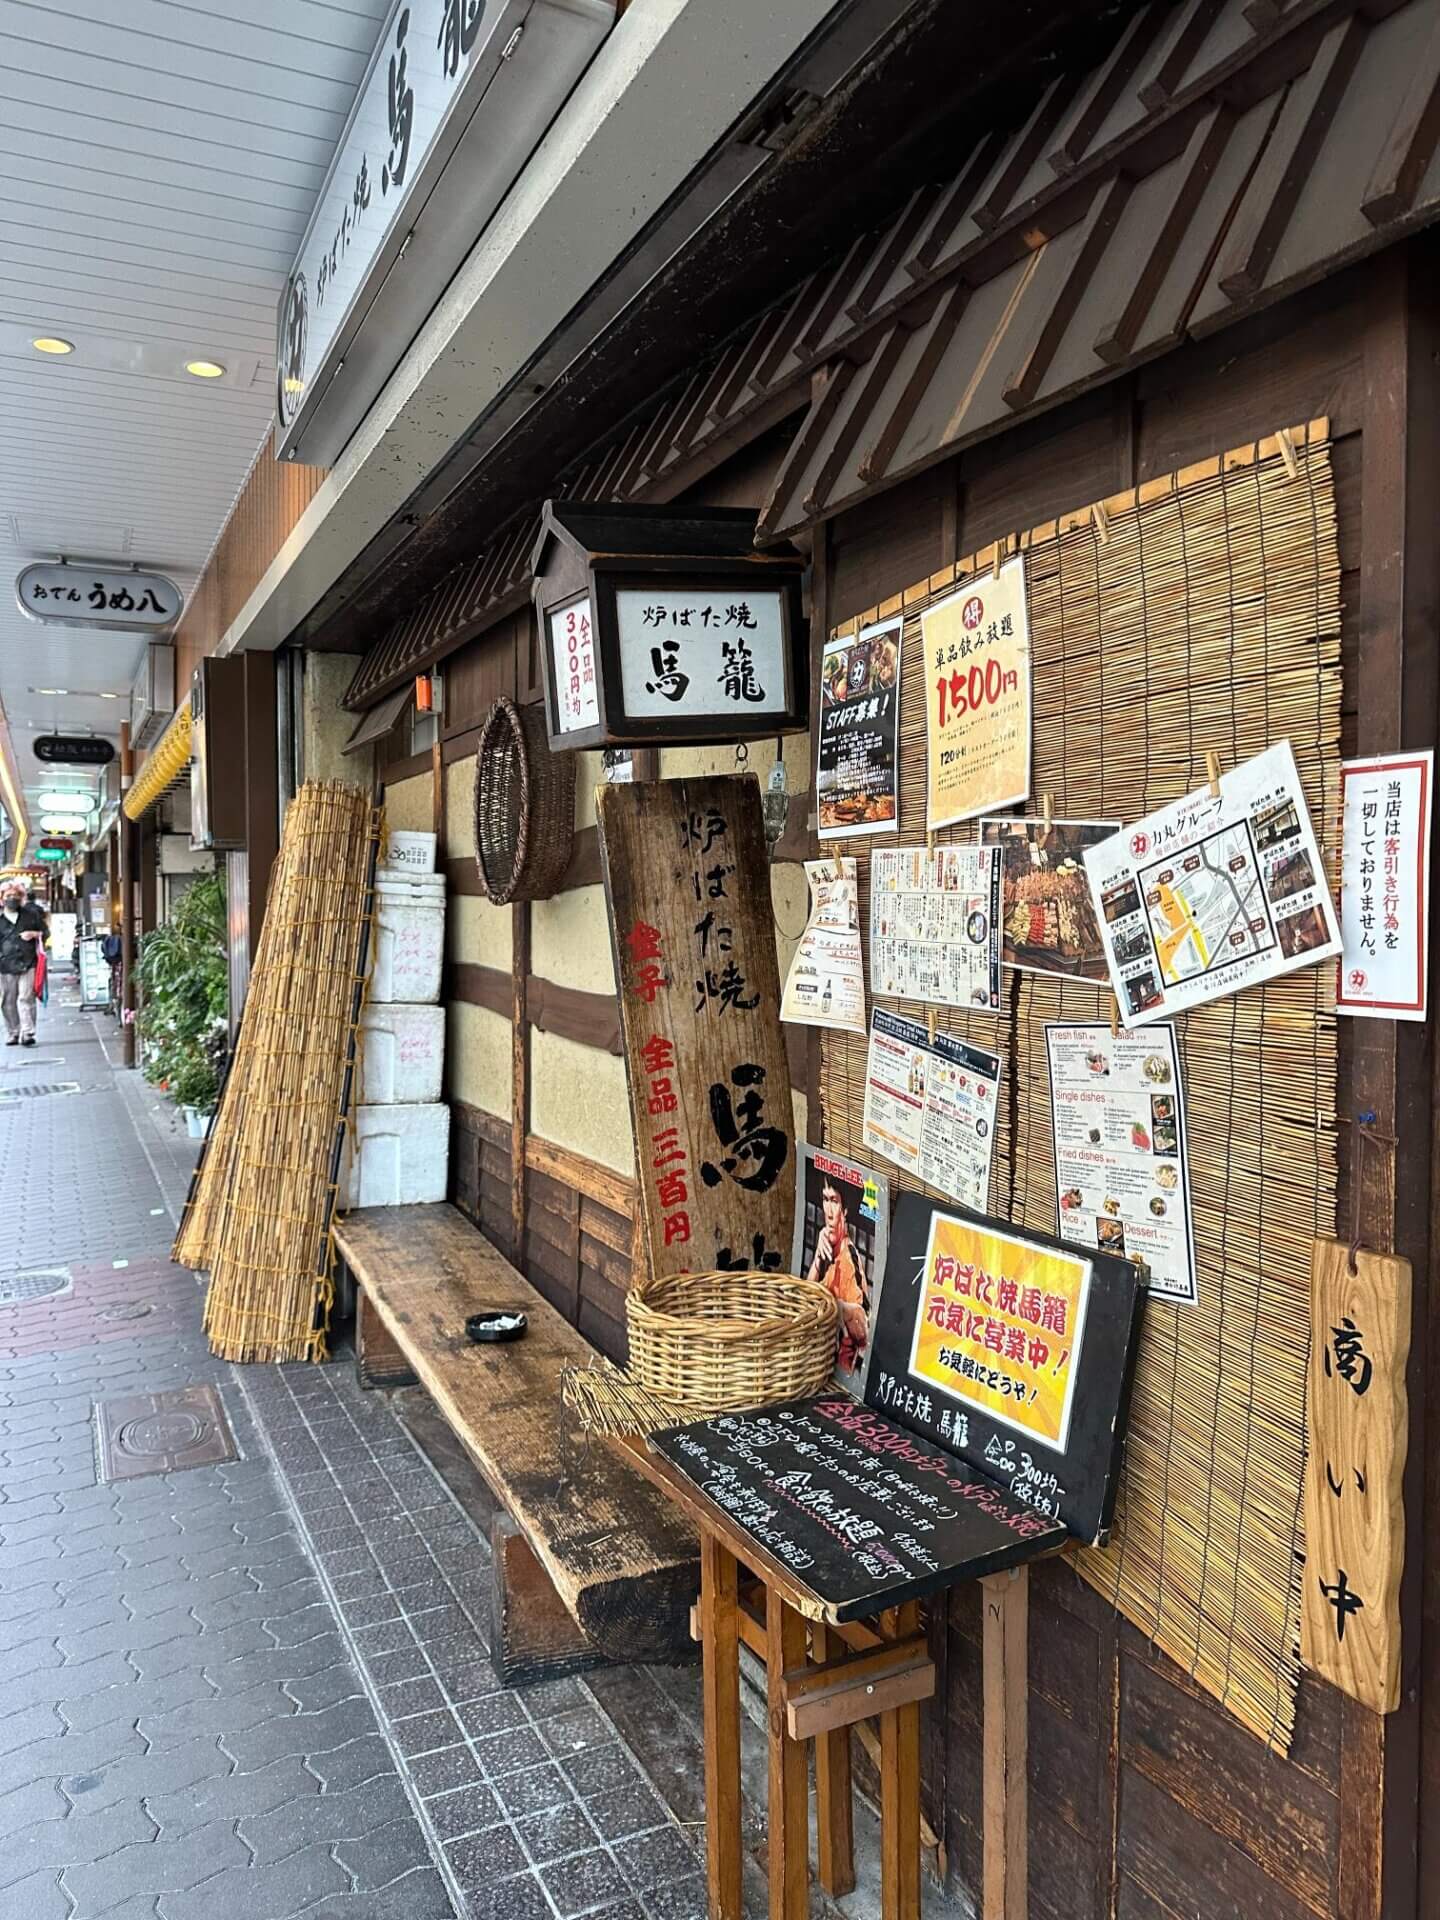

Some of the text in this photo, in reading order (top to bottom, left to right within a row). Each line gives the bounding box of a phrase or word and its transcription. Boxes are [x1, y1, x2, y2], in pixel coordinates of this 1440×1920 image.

[33, 582, 167, 613] おでん うめ八
[642, 602, 758, 629] 炉ばた焼
[646, 637, 766, 702] 馬籠
[934, 613, 1015, 672] 単品飲み放題
[1152, 799, 1226, 846] 力丸グループ
[1360, 787, 1379, 956] 一切しておりません。
[1383, 780, 1401, 950] 当店は客引き行為を
[680, 806, 762, 1017] 炉ばた焼
[1073, 1030, 1088, 1040] fish
[1055, 1090, 1105, 1103] Single dishes
[640, 1033, 692, 1276] 全品三百円
[815, 1155, 845, 1178] BRUCE
[1058, 1148, 1104, 1163] Fried dishes
[1062, 1213, 1079, 1225] Rice
[1124, 1223, 1158, 1239] Dessert
[933, 1253, 1068, 1336] 炉ばた焼馬籠
[926, 1295, 1069, 1376] 元気に営業中!
[938, 1346, 1039, 1406] お気軽にどうや!
[876, 1371, 969, 1448] 炉ばた焼 馬籠
[1318, 1317, 1373, 1643] 商い中
